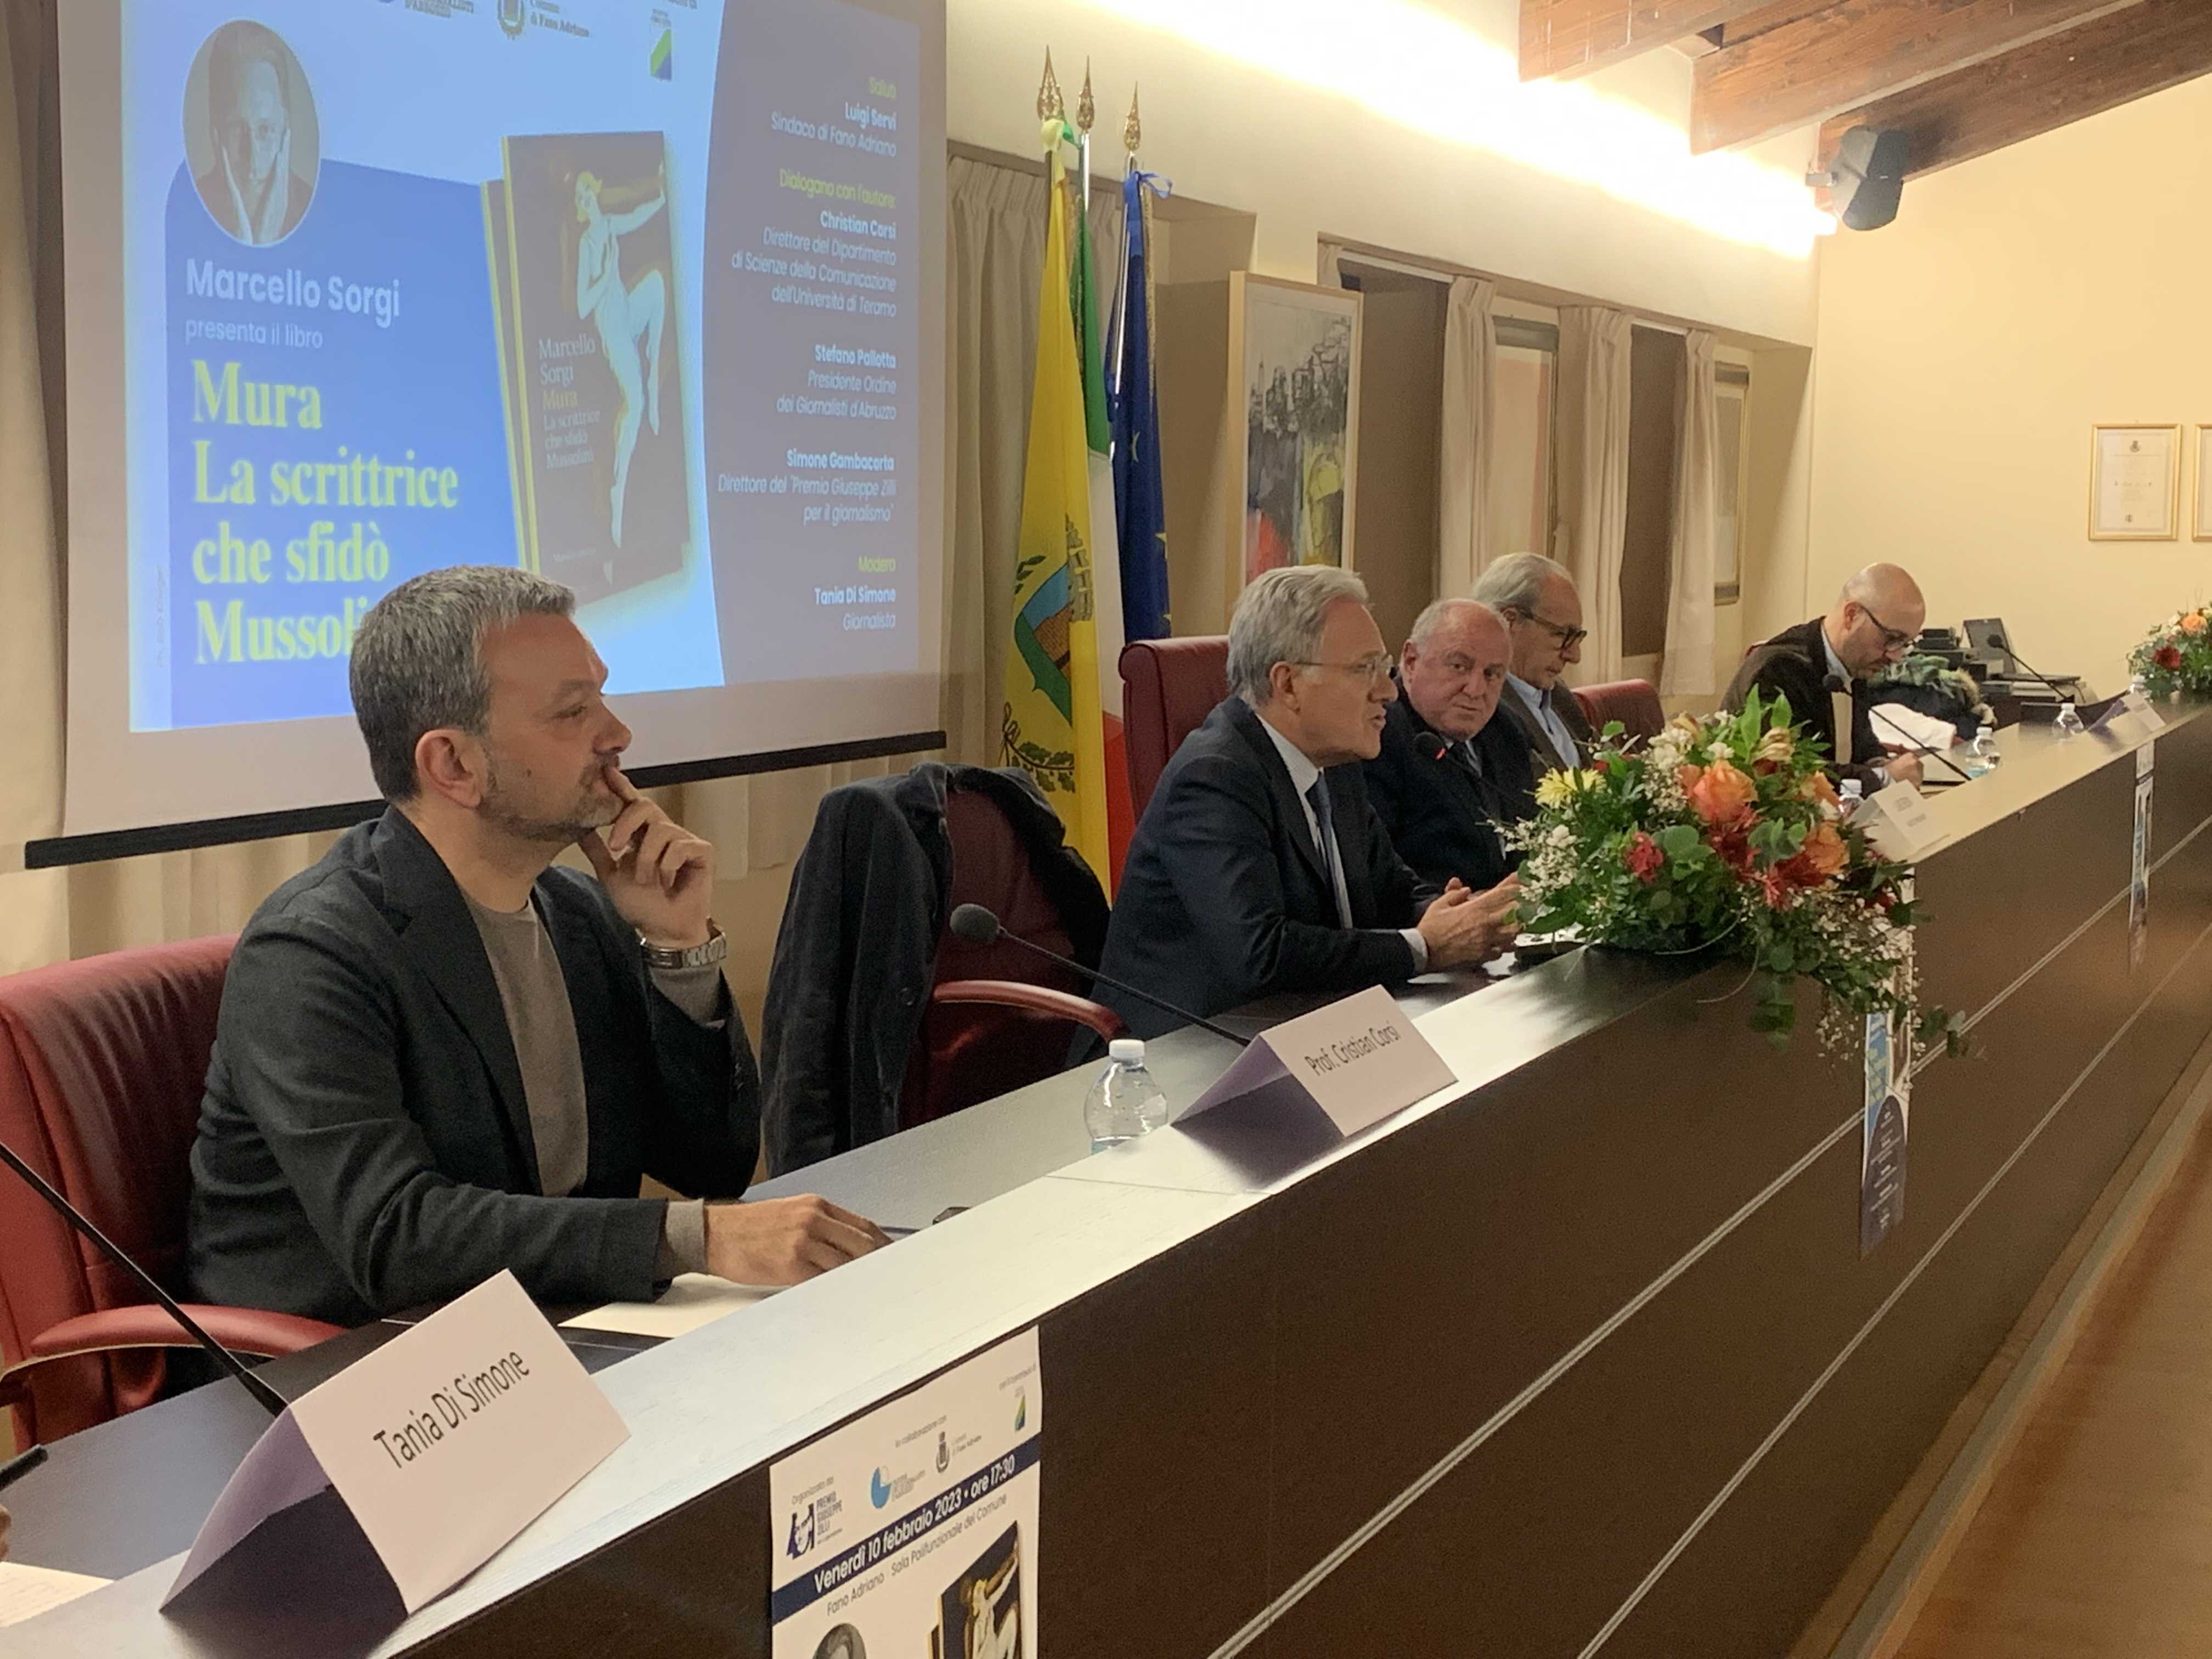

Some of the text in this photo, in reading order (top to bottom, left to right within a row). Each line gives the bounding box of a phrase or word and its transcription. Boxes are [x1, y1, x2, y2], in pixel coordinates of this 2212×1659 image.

[845, 102, 897, 130] Luigi Servi
[771, 110, 897, 156] Sindaco di Fano Adriano
[780, 168, 834, 198] Dialogano
[836, 184, 856, 201] con
[821, 211, 897, 240] Christian Corsi
[763, 227, 896, 266] Direttore del Dipartimento
[731, 250, 742, 268] di
[745, 251, 787, 275] Scienze
[818, 264, 896, 292] Comunicazione
[185, 258, 400, 329] Marcello Sorgi
[846, 295, 857, 312] di
[859, 296, 896, 317] Teramo
[185, 318, 323, 349] presenta il libro
[539, 332, 596, 360] Marcello
[815, 344, 896, 369] Stefano Pallotta
[540, 363, 574, 388] Sorgi
[807, 370, 896, 394] Presidente Ordine
[191, 360, 324, 430] Mura
[776, 394, 794, 413] dei
[796, 396, 848, 417] Giornalisti
[787, 447, 895, 471] Simone Gambacorta
[192, 441, 459, 508] La scrittrice
[718, 472, 767, 493] Direttore
[769, 474, 787, 493] del
[831, 477, 879, 501] Giuseppe
[803, 506, 822, 527] per
[192, 521, 391, 584] che sfidò
[815, 584, 896, 605] Tania Di Simone
[843, 612, 896, 631] Giornalista
[1304, 1020, 1401, 1076] Prof. Cristian Corsi
[373, 1351, 530, 1469] Tania Di Simone
[814, 1454, 1015, 1593] Venerdì 10 febbraio 2023 ore 17:30
[827, 1493, 1008, 1616] Fano Adriano Sala Polifunzionale del Comune
